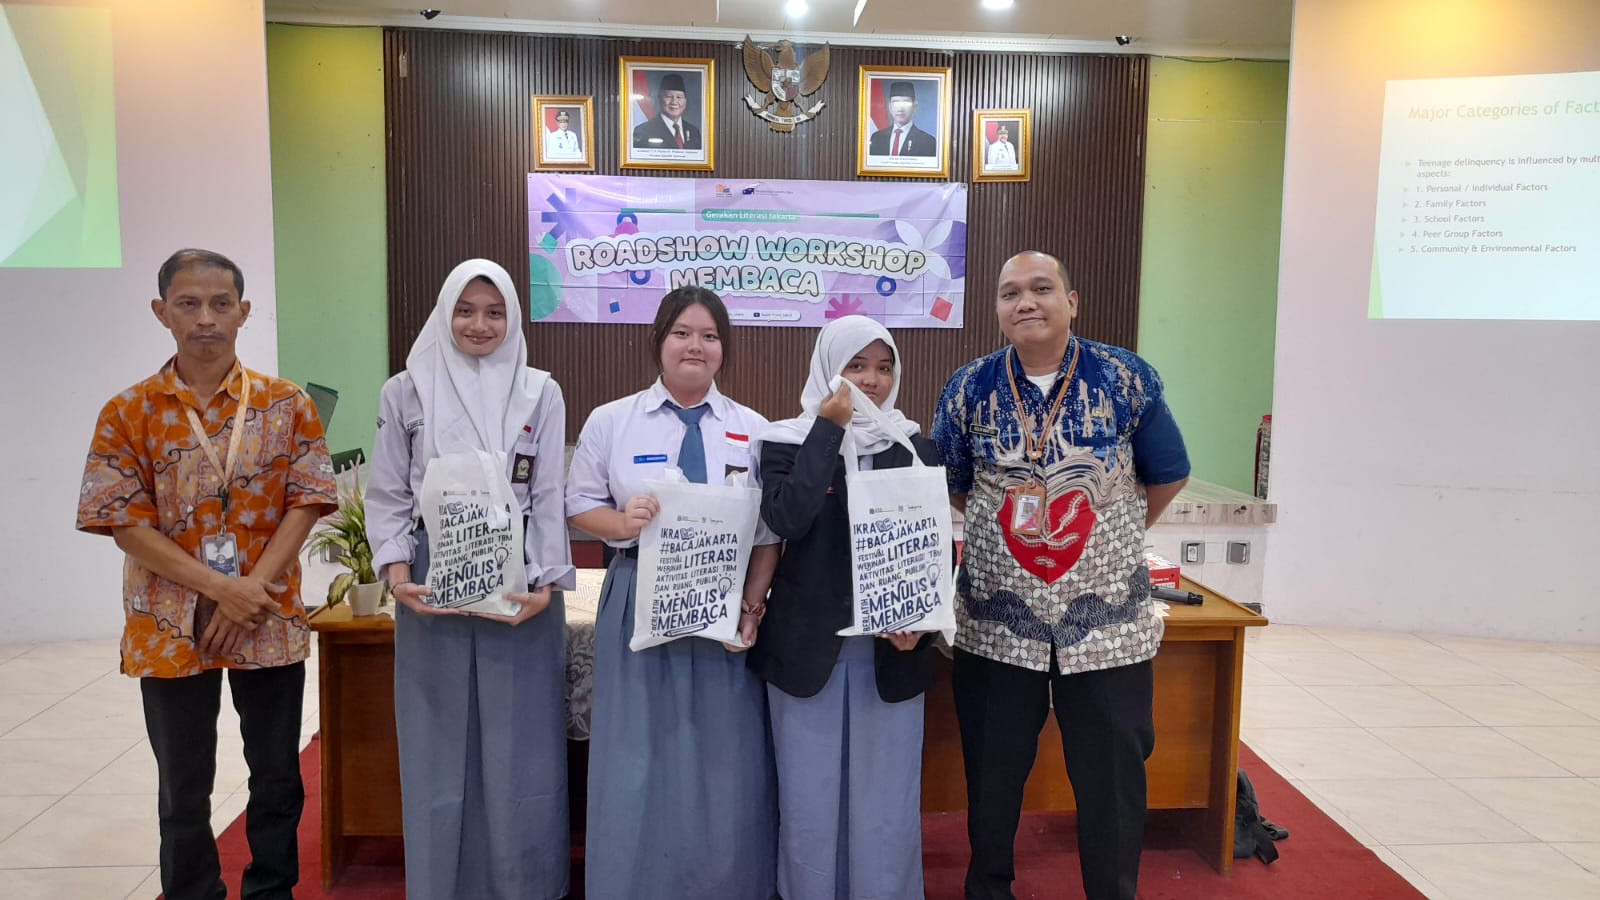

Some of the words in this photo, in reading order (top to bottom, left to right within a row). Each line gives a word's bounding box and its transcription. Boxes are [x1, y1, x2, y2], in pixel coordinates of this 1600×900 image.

[1408, 105, 1451, 122] Major
[1456, 103, 1538, 120] Categories
[1543, 101, 1560, 116] of
[1418, 159, 1452, 168] Teenage
[1454, 157, 1506, 167] delinquency
[1508, 157, 1516, 165] is
[1518, 156, 1564, 165] influenced
[1566, 155, 1577, 165] by
[1416, 170, 1450, 179] aspects:
[1426, 185, 1461, 193] Personal
[1472, 184, 1513, 192] Individual
[1516, 184, 1548, 192] Factors
[1414, 201, 1422, 209] 2.
[1425, 200, 1453, 209] Family
[1455, 200, 1487, 208] Factors
[706, 210, 738, 219] Gerakan
[1424, 215, 1451, 223] School
[1453, 215, 1485, 223] Factors
[1423, 230, 1442, 238] Peer
[1443, 230, 1470, 240] Group
[1471, 230, 1503, 238] Factors
[571, 235, 749, 271] ROADSHOW
[756, 235, 926, 275] WORKSHOP
[1409, 245, 1418, 253] 5.
[1421, 245, 1469, 254] Community
[671, 265, 819, 297] MEMBACA
[661, 528, 680, 540] IKRA
[853, 522, 877, 535] IKRA
[856, 516, 938, 552] #BACAJAKARTA
[465, 537, 494, 551] LITERASI
[498, 534, 512, 543] TBM
[659, 533, 738, 554] #BACAJAKARTA
[888, 532, 940, 562] LITERASI
[444, 554, 468, 566] RUANG
[471, 545, 494, 558] PUBLIK
[684, 548, 737, 569] LITERASI
[857, 558, 886, 571] WEBINAR
[858, 549, 884, 562] FESTIVAL
[436, 560, 494, 590] MENULIS
[656, 572, 688, 582] AKTIVITAS
[690, 566, 718, 578] LITERASI
[859, 566, 894, 581] AKTIVITAS
[859, 582, 875, 593] DAN
[879, 573, 902, 586] RUANG
[433, 573, 504, 604] MEMBACA
[654, 584, 670, 594] DAN
[673, 581, 693, 590] RUANG
[696, 575, 718, 586] PUBLIK
[660, 588, 718, 614] MENULIS
[869, 577, 928, 613] MENULIS
[658, 604, 728, 630] MEMBACA
[870, 591, 942, 630] MEMBACA
